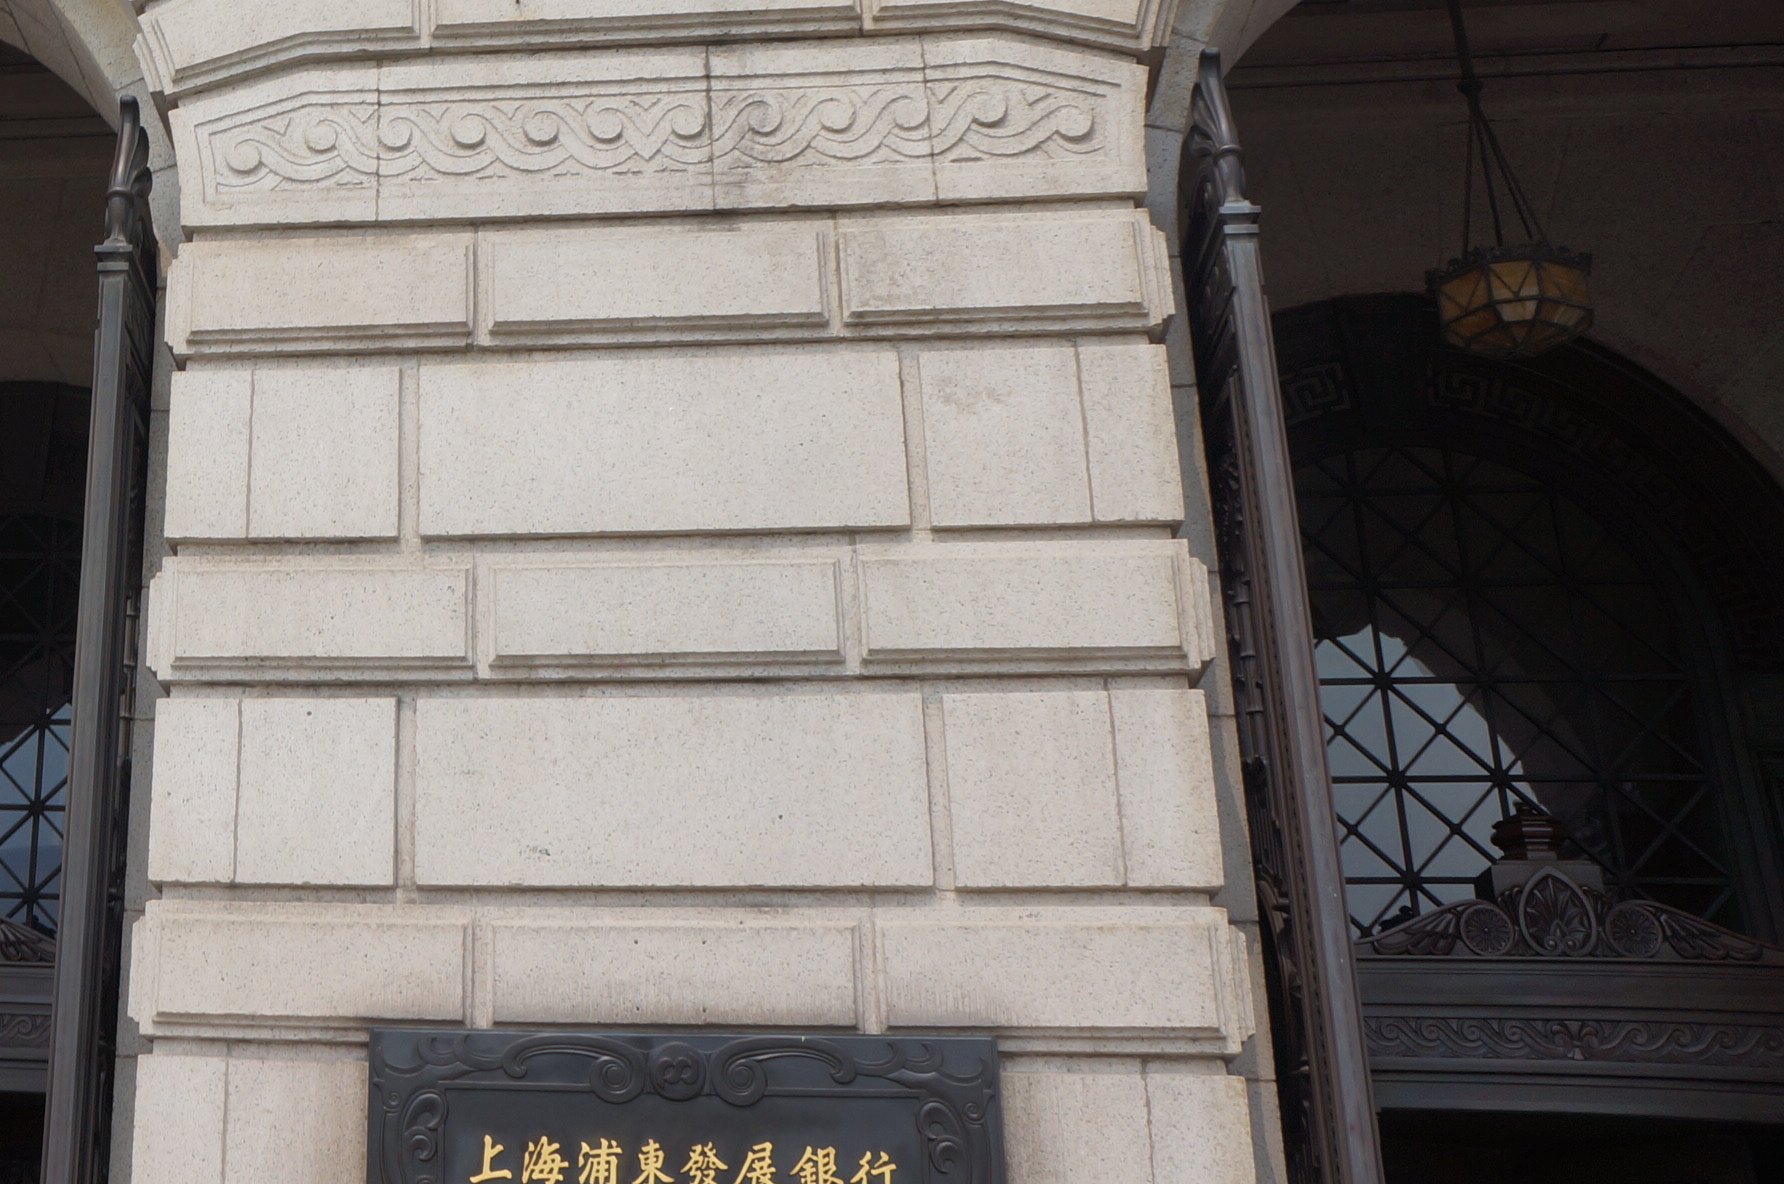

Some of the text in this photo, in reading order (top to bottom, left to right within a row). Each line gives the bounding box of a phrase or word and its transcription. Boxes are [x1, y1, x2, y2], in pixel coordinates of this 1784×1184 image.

[469, 1134, 897, 1184] 上海浦東發展銀行
